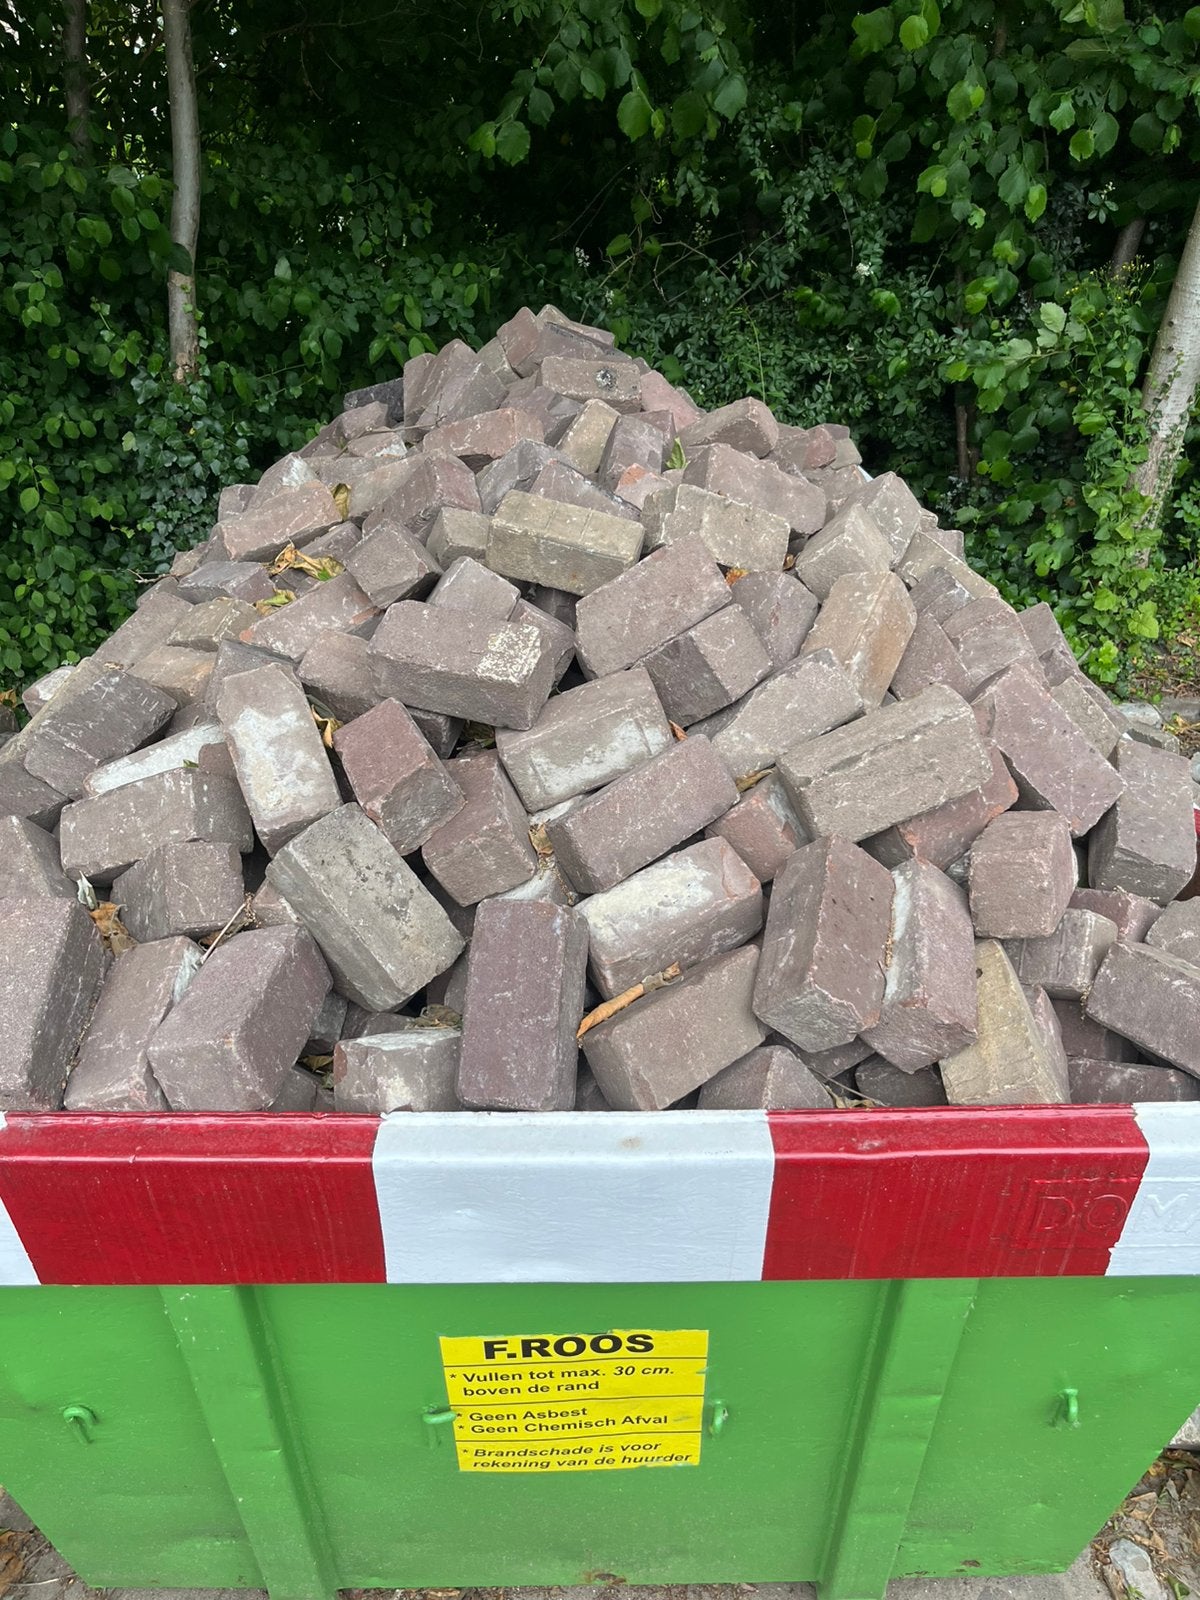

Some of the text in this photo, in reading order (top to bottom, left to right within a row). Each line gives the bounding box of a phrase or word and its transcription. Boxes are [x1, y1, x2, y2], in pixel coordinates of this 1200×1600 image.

[1031, 1193, 1200, 1232] DOM
[484, 1334, 654, 1359] F.ROOS
[463, 1365, 674, 1383] Vullen tot max. 30 cm.
[463, 1381, 600, 1396] boven de rand
[469, 1407, 588, 1421] Geen Asbest
[471, 1415, 668, 1434] Geen Chemisch Afval
[474, 1443, 662, 1457] Brandschade is voor
[473, 1460, 551, 1469] rekening
[594, 1456, 616, 1465] de
[621, 1453, 692, 1464] huurder
